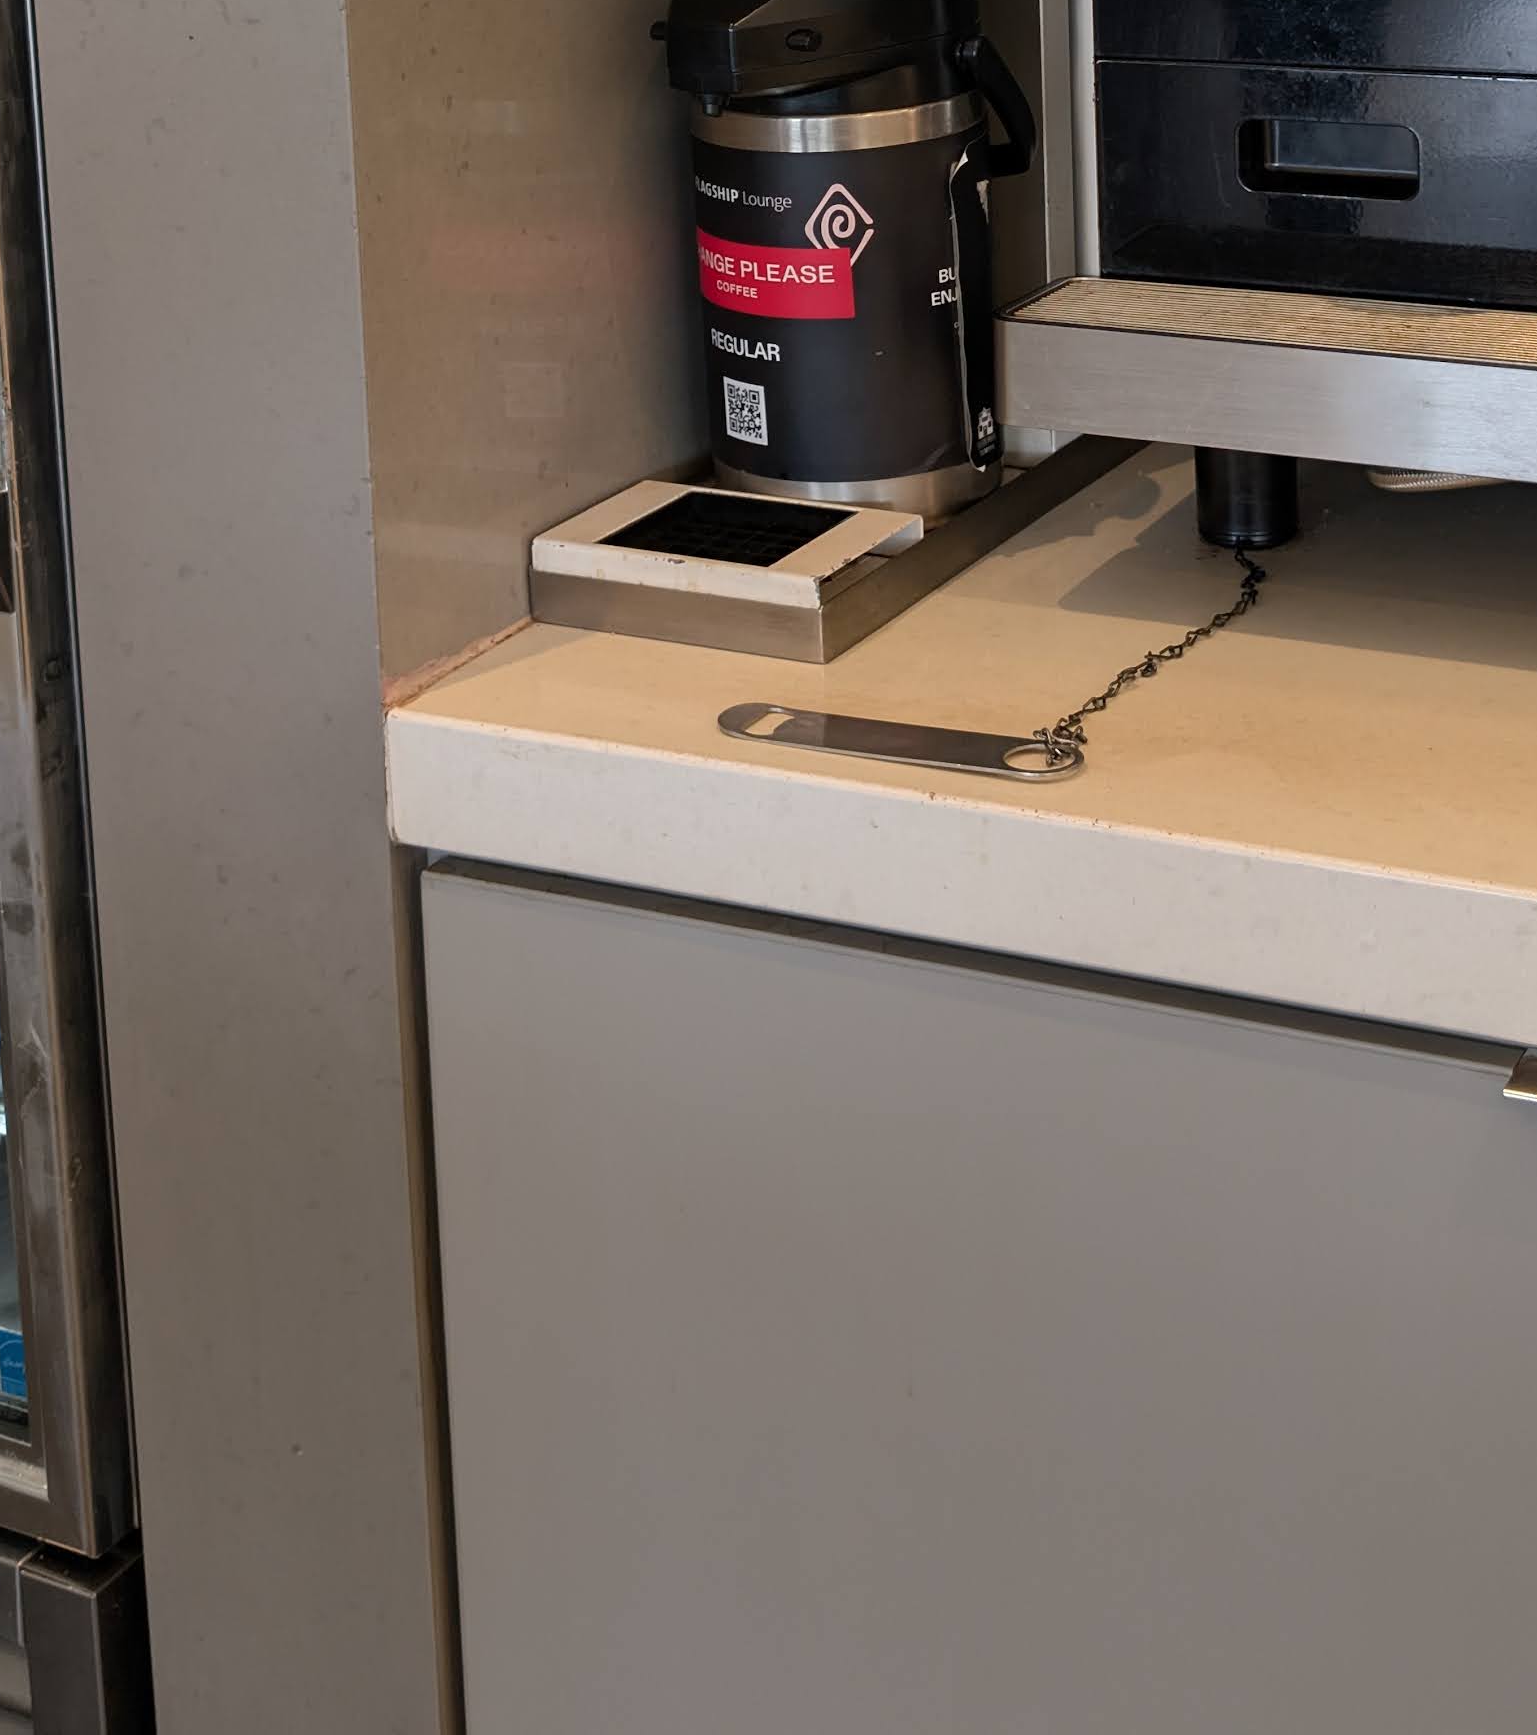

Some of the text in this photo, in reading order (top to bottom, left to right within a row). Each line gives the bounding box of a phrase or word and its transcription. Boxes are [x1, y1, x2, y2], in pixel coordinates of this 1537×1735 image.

[742, 191, 792, 213] Lounge
[740, 259, 835, 284] PLEASE
[716, 279, 758, 299] COFFEE
[711, 327, 780, 362] REGULAR
